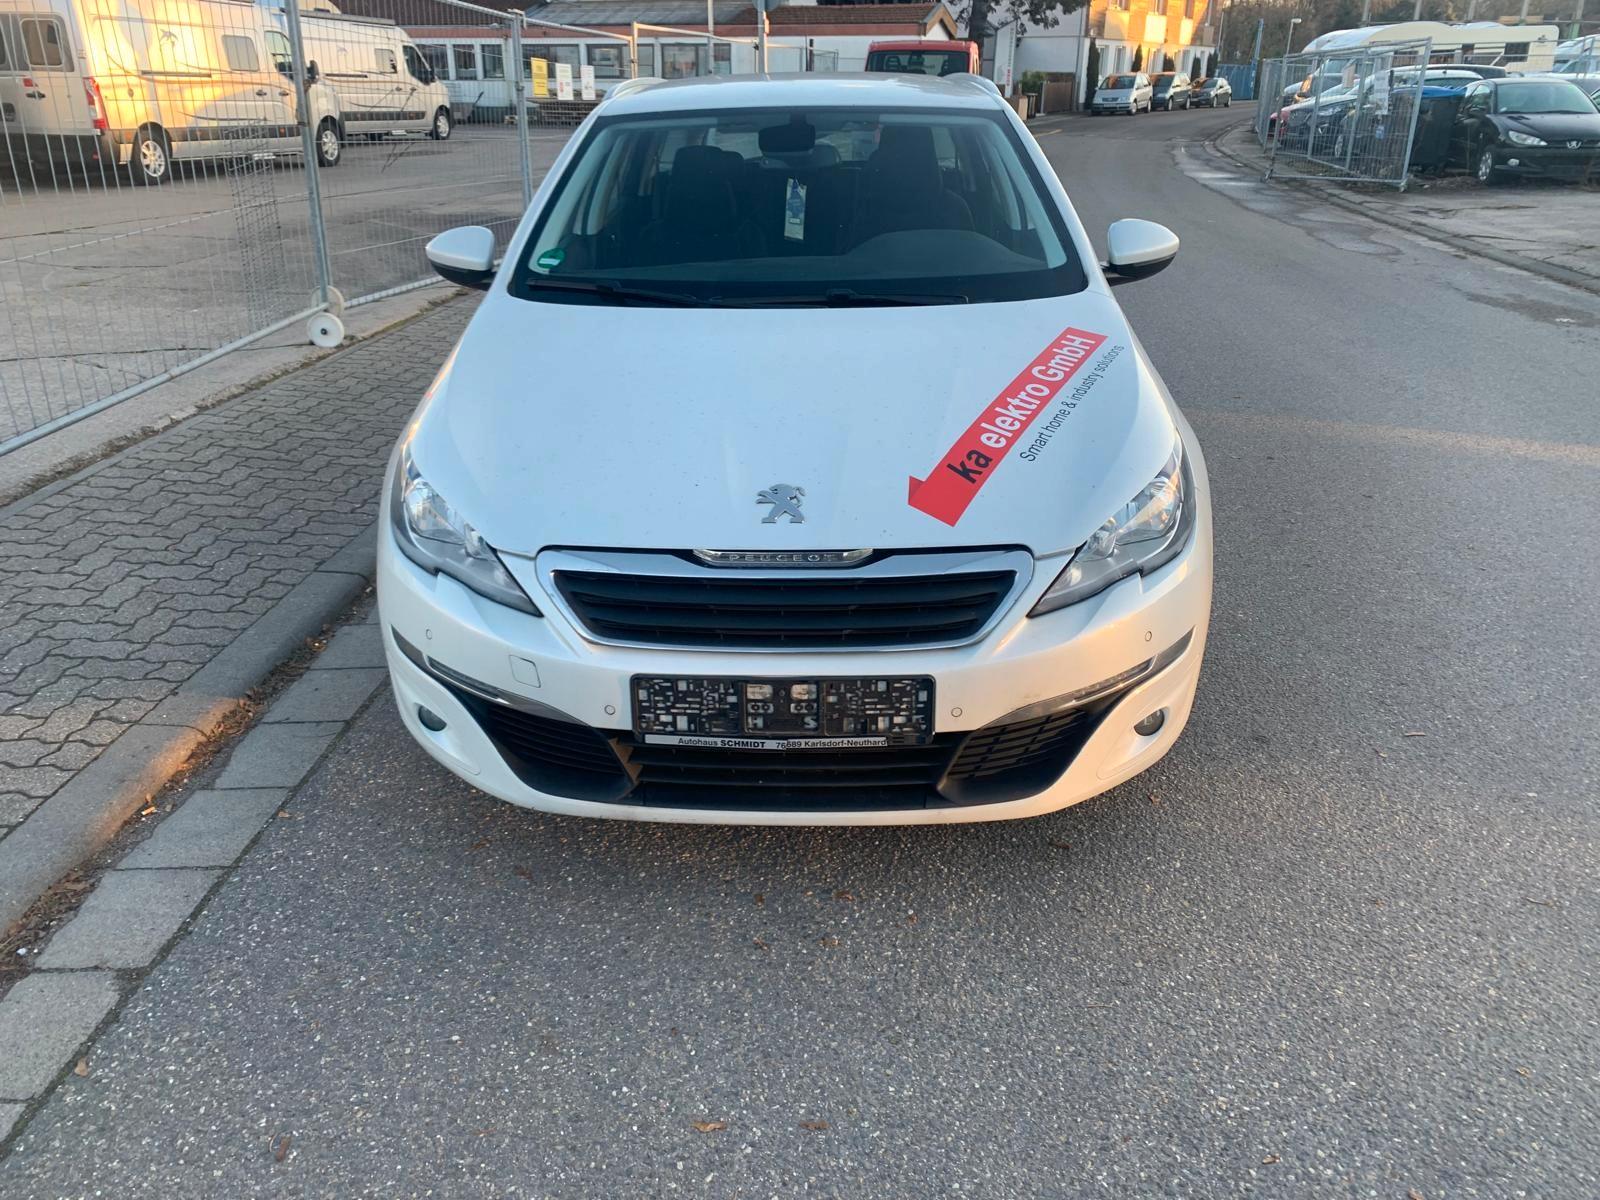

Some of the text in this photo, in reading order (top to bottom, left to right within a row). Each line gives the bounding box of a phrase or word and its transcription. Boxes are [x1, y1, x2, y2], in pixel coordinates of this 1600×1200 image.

[946, 335, 1097, 484] ka elektro GmbH
[1019, 344, 1125, 462] Smart home & industry solutions
[729, 554, 836, 562] PEUGEOT
[677, 737, 718, 747] Autohaus
[720, 739, 766, 749] SCHMIDT
[804, 738, 887, 748] Karlsdorf-Neuthard
